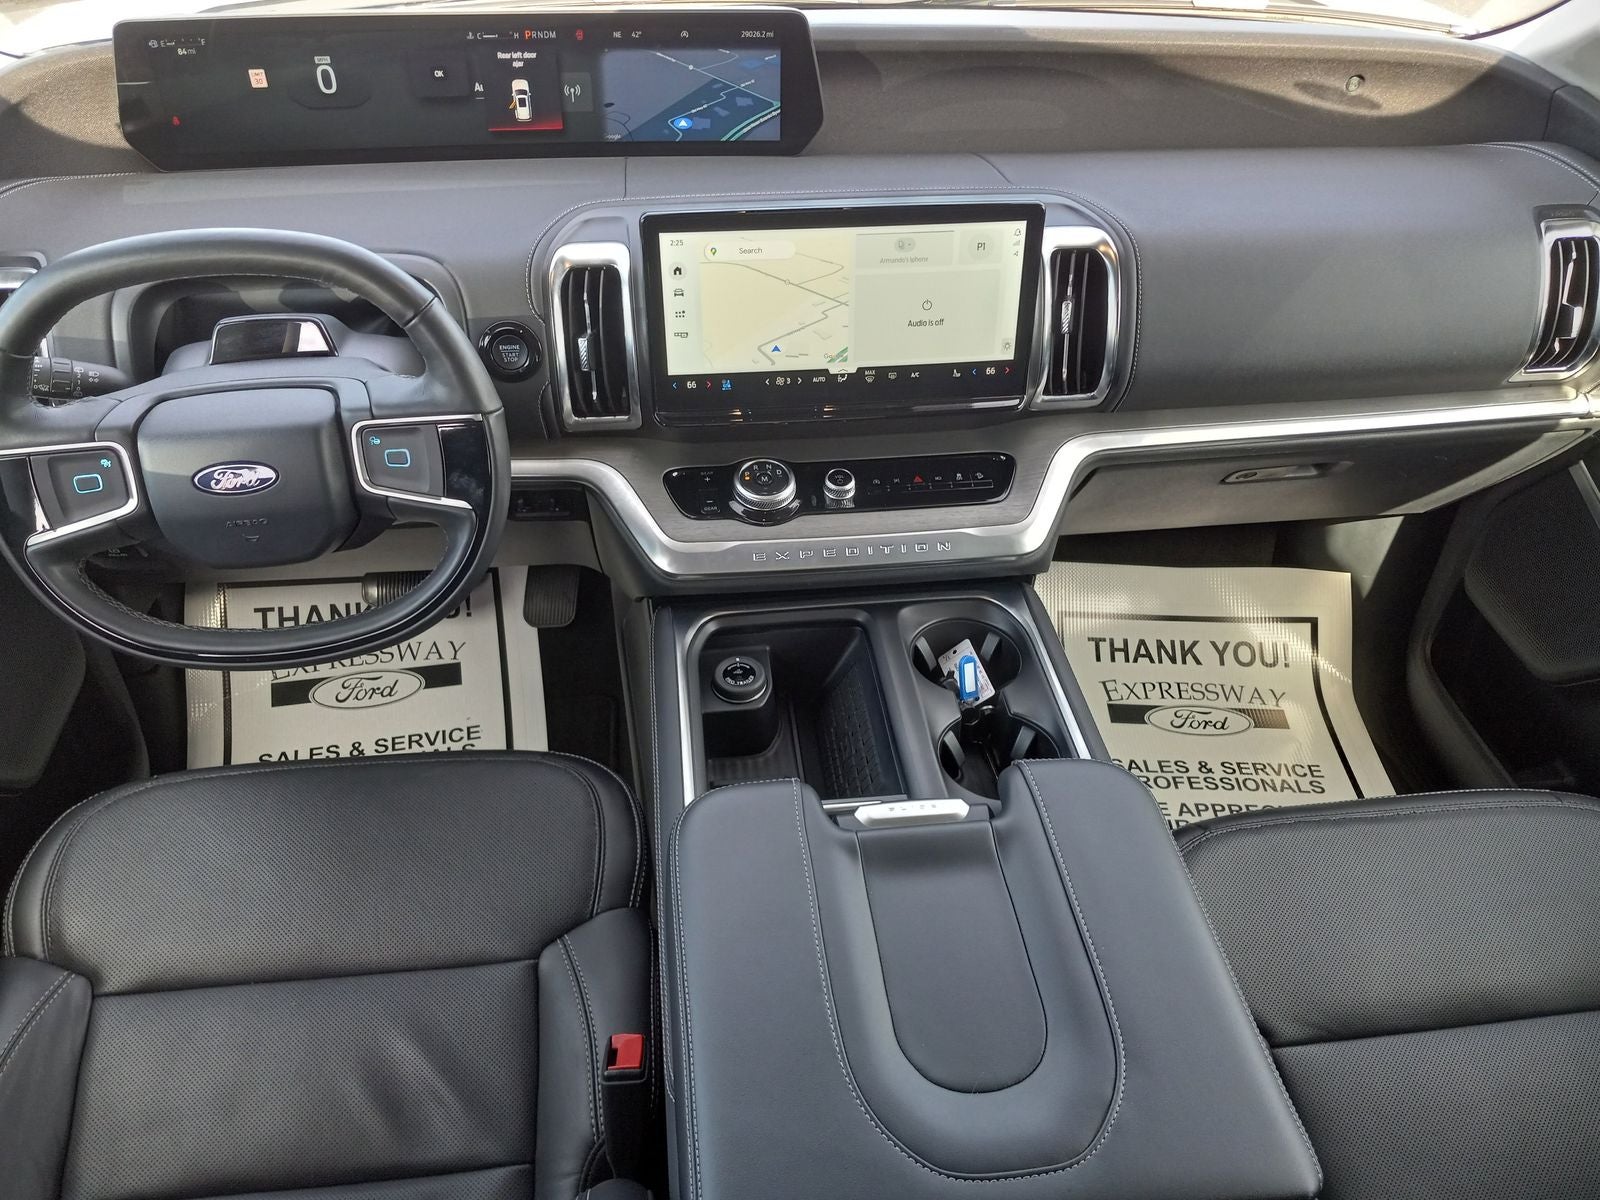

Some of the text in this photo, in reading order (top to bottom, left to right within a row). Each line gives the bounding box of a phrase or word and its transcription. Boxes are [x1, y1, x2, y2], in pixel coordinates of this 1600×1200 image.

[511, 51, 523, 59] left
[523, 51, 537, 59] door
[316, 64, 337, 94] 0
[434, 70, 444, 78] OK
[738, 247, 763, 255] Search
[976, 242, 986, 251] P1
[907, 318, 945, 328] Audio is off
[985, 367, 996, 375] 66
[686, 381, 697, 389] 66
[210, 468, 261, 491] Ford
[752, 541, 951, 562] EXPEDITION
[1087, 636, 1291, 669] THANK YOU!
[335, 676, 400, 704] Ford
[1098, 679, 1287, 708] EXPRESSWAY
[1170, 709, 1230, 730] Ford
[349, 741, 366, 757] &
[374, 724, 482, 754] SERVICE
[1197, 759, 1215, 775] &
[1219, 760, 1326, 779] SERVICE
[1137, 775, 1326, 795] ROFESSIONALS
